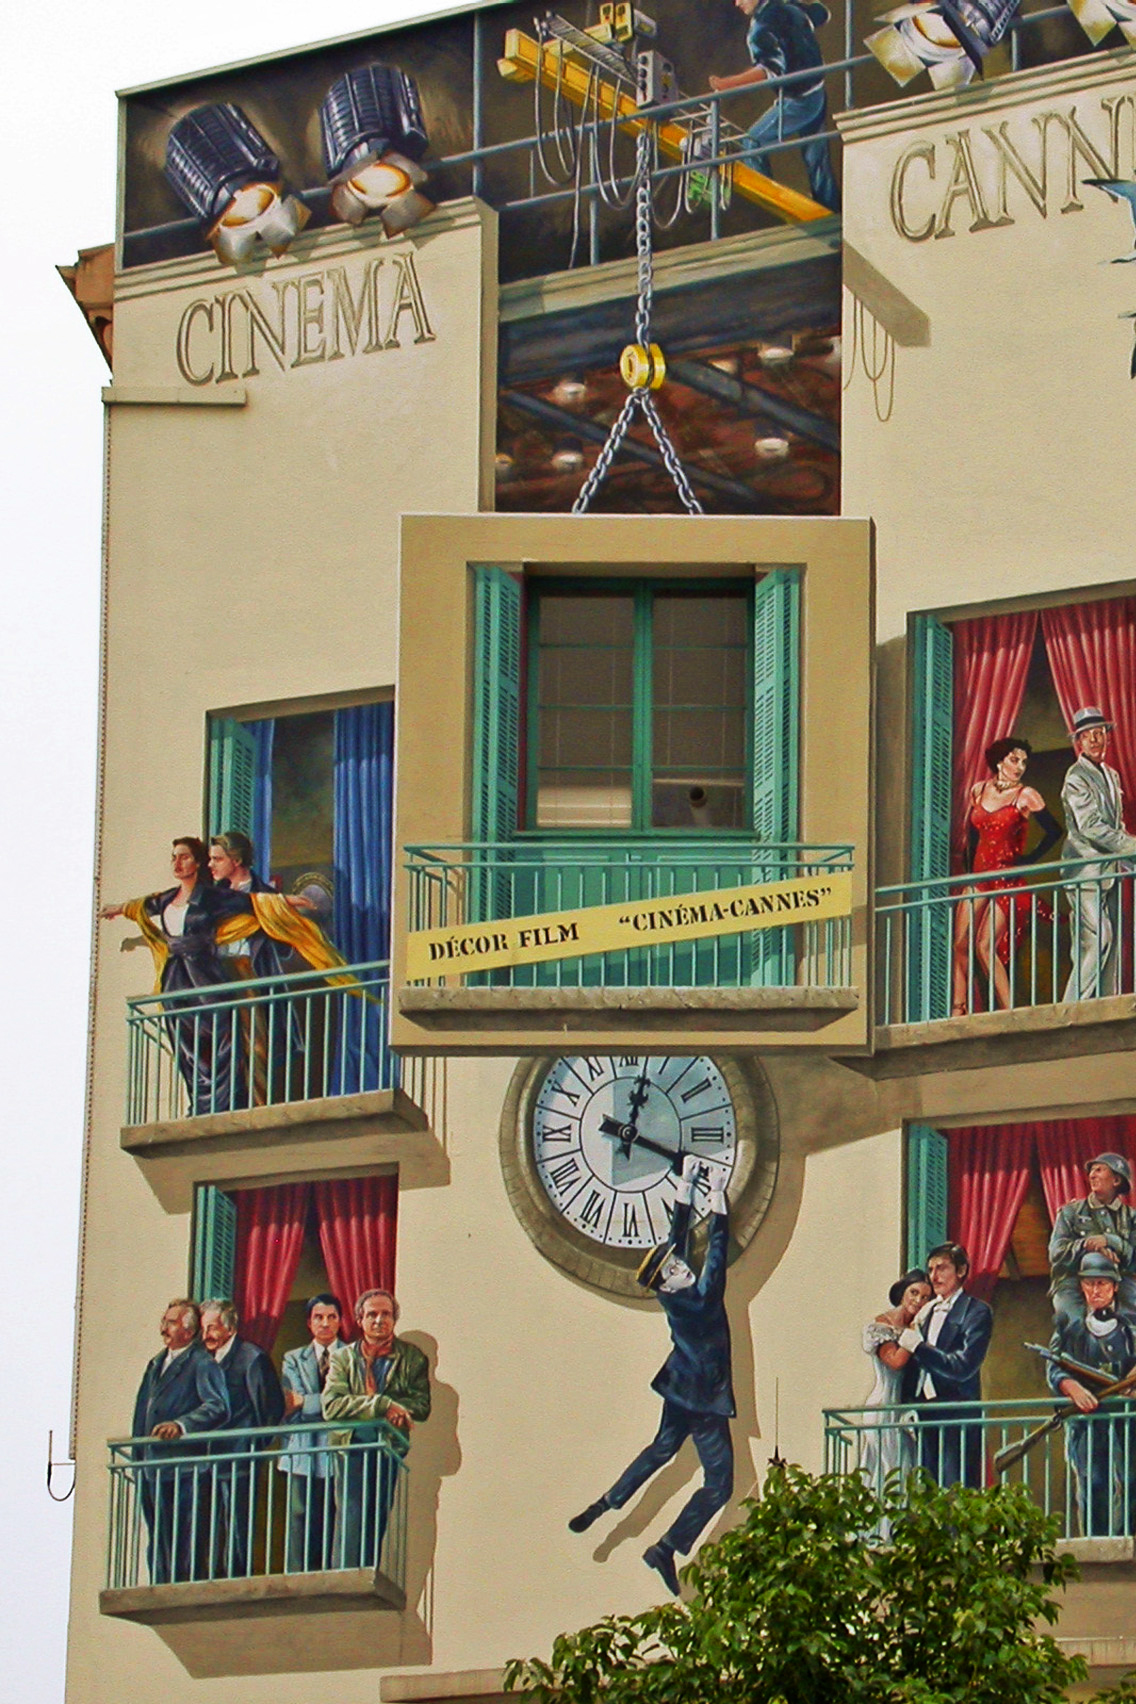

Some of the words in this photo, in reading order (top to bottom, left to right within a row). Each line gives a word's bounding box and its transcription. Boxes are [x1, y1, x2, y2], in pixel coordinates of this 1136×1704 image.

[176, 250, 437, 386] CINEMA
[428, 931, 509, 962] DÉCOR
[518, 921, 580, 949] FILM
